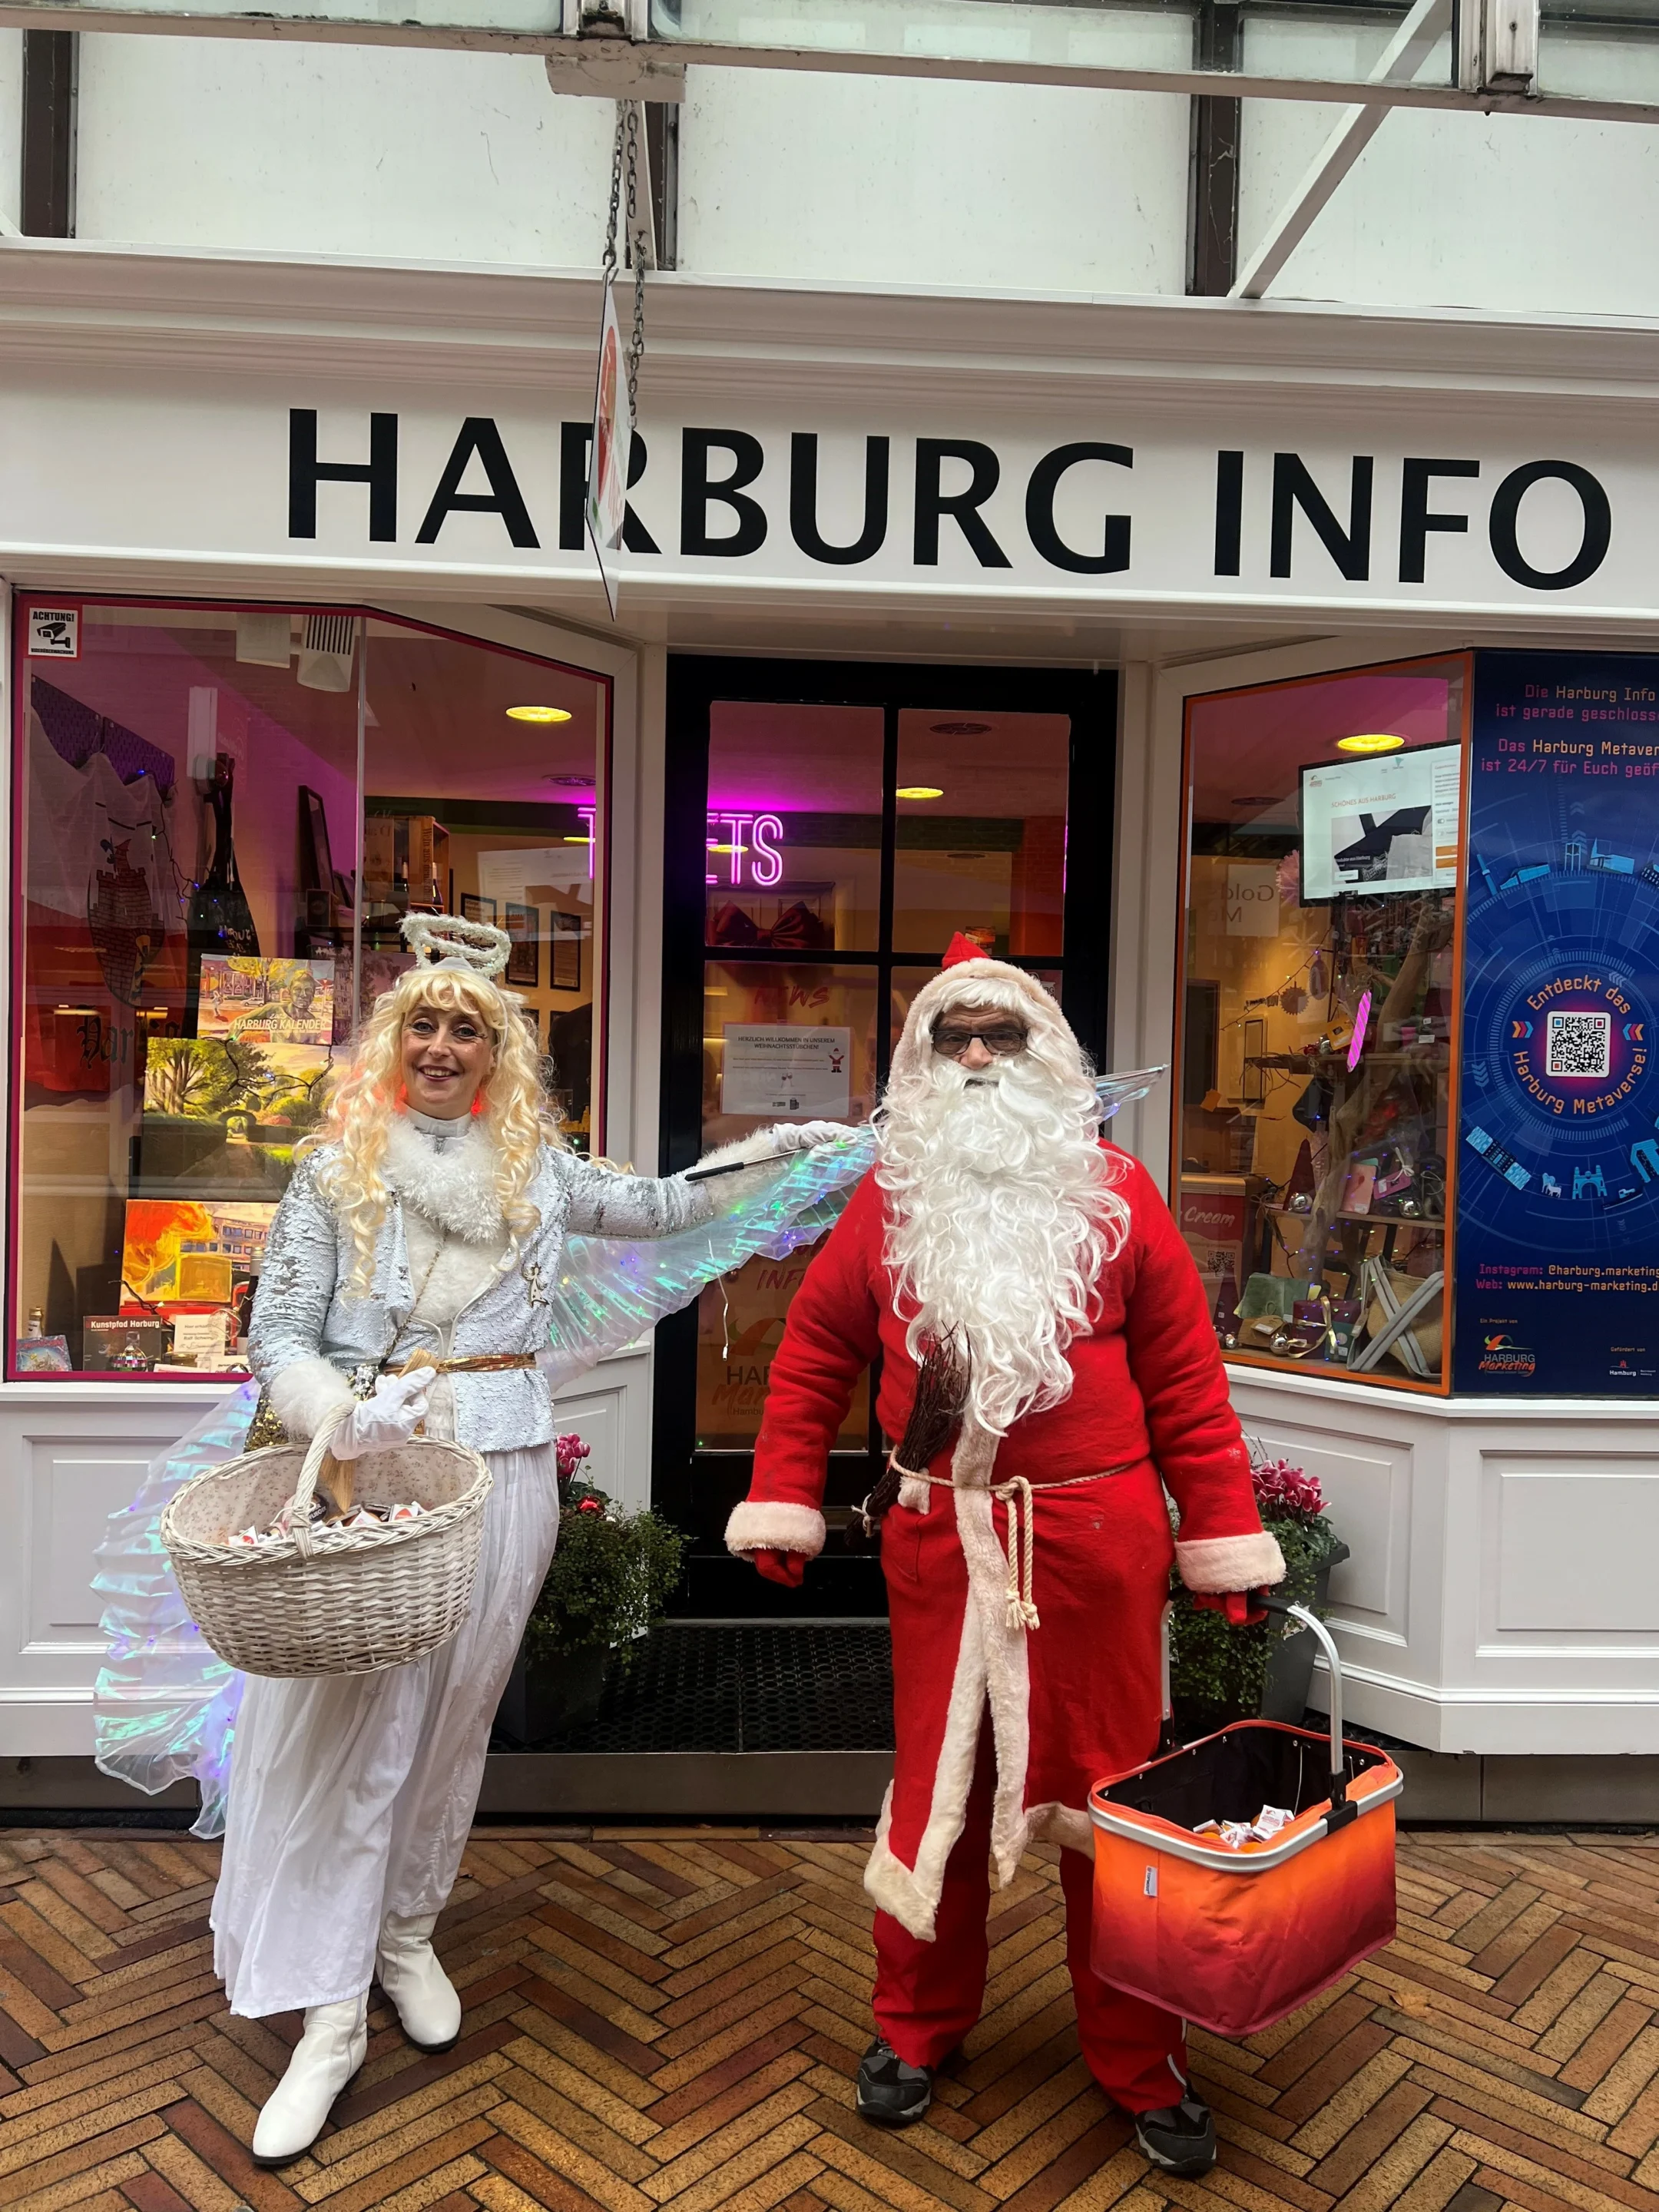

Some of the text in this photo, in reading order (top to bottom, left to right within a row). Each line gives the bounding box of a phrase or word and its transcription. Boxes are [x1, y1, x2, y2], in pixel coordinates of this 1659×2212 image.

[289, 408, 1134, 574] HARBURG
[1214, 449, 1612, 591] INFO
[32, 611, 75, 622] ACHTUNG!
[1525, 684, 1656, 703] Die Harburg Info
[1495, 704, 1659, 722] ist gerade geschloss
[1498, 738, 1526, 752] Das
[1533, 739, 1594, 757] Harburg
[1481, 757, 1502, 772] ist
[1508, 759, 1547, 773] 24/7
[1552, 760, 1577, 774] für
[1583, 760, 1618, 776] Euch
[1331, 793, 1396, 808] SCHÖNES AUS HARBURG
[1526, 974, 1631, 1015] Entdeckt das
[233, 1018, 326, 1030] HARBURG KALENDER
[1513, 1048, 1647, 1114] Harburg Metaverse!
[1184, 1206, 1236, 1228] Cream
[1479, 1263, 1544, 1276] Instagram:
[757, 1269, 806, 1291] INF
[1475, 1279, 1659, 1293] Web: www.harburg-marketing.d
[91, 1320, 160, 1330] Kunstpfad Harburg
[1484, 1354, 1535, 1363] HARBURG
[1479, 1361, 1536, 1375] Marketing
